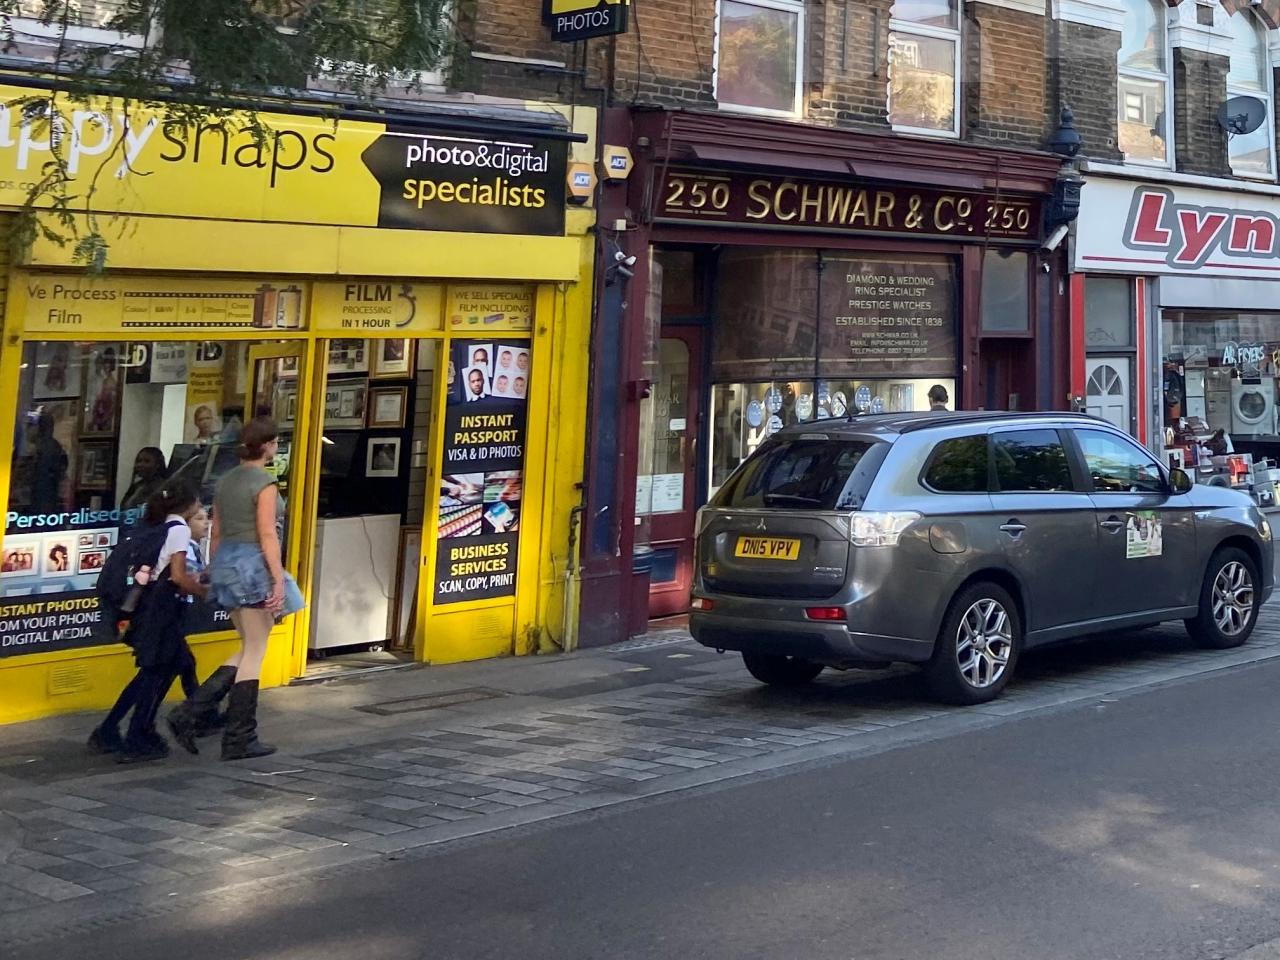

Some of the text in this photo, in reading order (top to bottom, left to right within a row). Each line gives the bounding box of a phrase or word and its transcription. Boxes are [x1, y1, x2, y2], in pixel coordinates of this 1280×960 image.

[557, 10, 610, 33] PHOTOS
[611, 158, 626, 169] ADT
[574, 174, 590, 186] ADT
[403, 177, 546, 208] specialists
[665, 178, 730, 209] 250
[746, 180, 895, 227] SCHWAR
[904, 194, 925, 229] &
[985, 205, 1030, 230] 250
[846, 274, 935, 286] DIAMOND & WEDDING
[53, 285, 117, 301] Process
[344, 284, 392, 302] FILM
[456, 291, 469, 300] WE
[471, 292, 492, 300] SELL
[855, 287, 927, 296] RING SPECIALIST
[342, 306, 392, 315] PROCESSING
[459, 304, 529, 313] FILM INCLUDING
[849, 300, 931, 310] PRESTIGE WATCHES
[48, 309, 82, 324] Film
[342, 319, 391, 328] IN 1 HOUR
[836, 316, 894, 326] ESTABLISHED
[896, 317, 922, 326] SINCE
[461, 414, 514, 428] INSTANT
[454, 430, 518, 445] PASSPORT
[448, 445, 522, 461] VISA & ID PHOTOS
[451, 543, 509, 560] BUSINESS
[742, 539, 793, 556] DN15 VPV
[451, 558, 507, 576] SERVICES
[439, 573, 514, 593] SCAN, COPY, PRINT
[47, 597, 99, 613] PHOTOS
[22, 615, 56, 630] YOUR
[58, 611, 101, 626] PHONE
[2, 626, 92, 647] DIGITAL MEDIA
